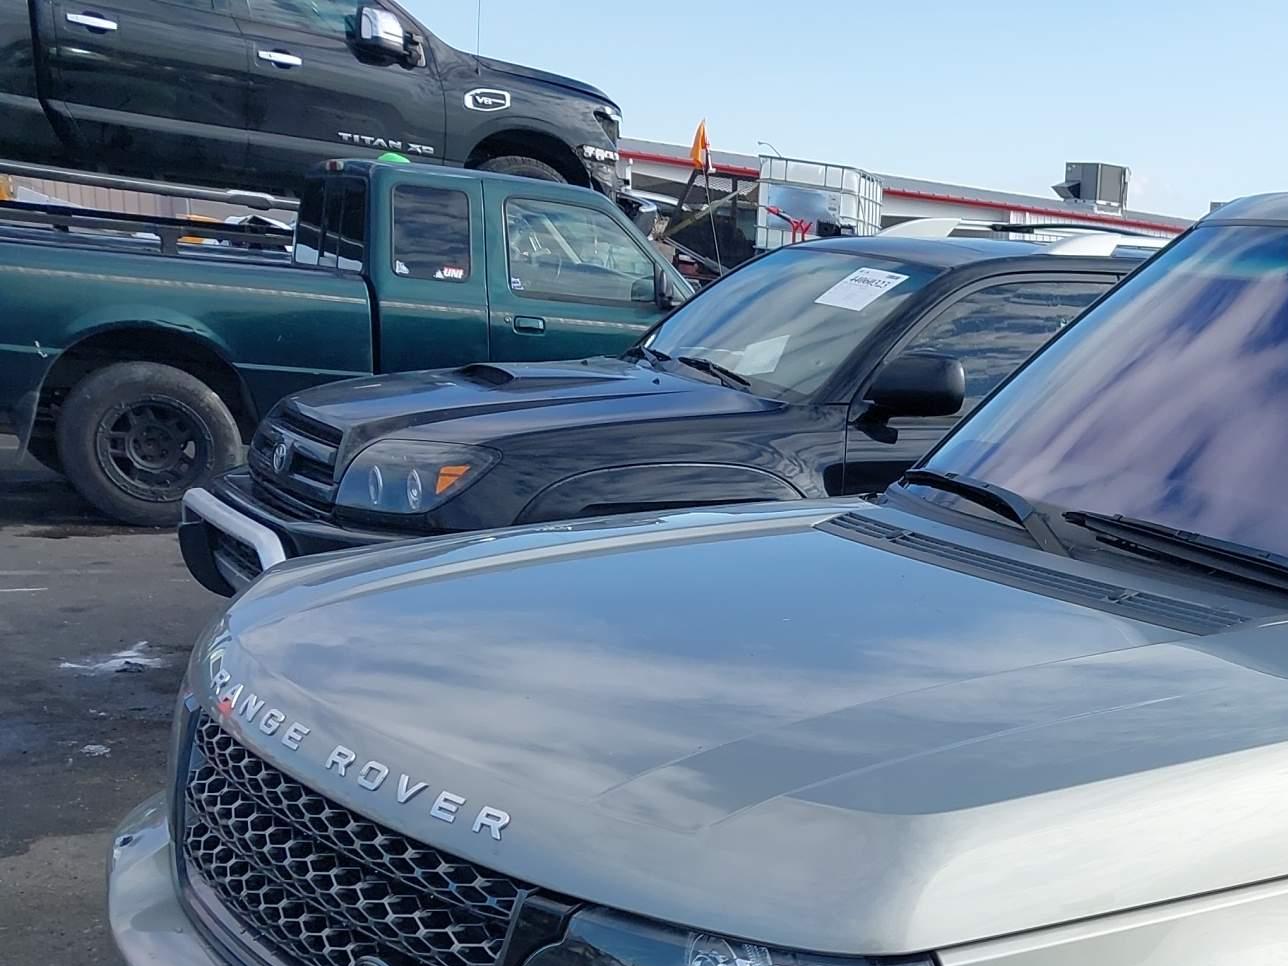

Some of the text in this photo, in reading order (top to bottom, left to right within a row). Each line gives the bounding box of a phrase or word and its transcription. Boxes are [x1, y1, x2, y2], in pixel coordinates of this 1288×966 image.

[337, 132, 402, 150] TITAN
[209, 668, 511, 841] RANGE ROVER
